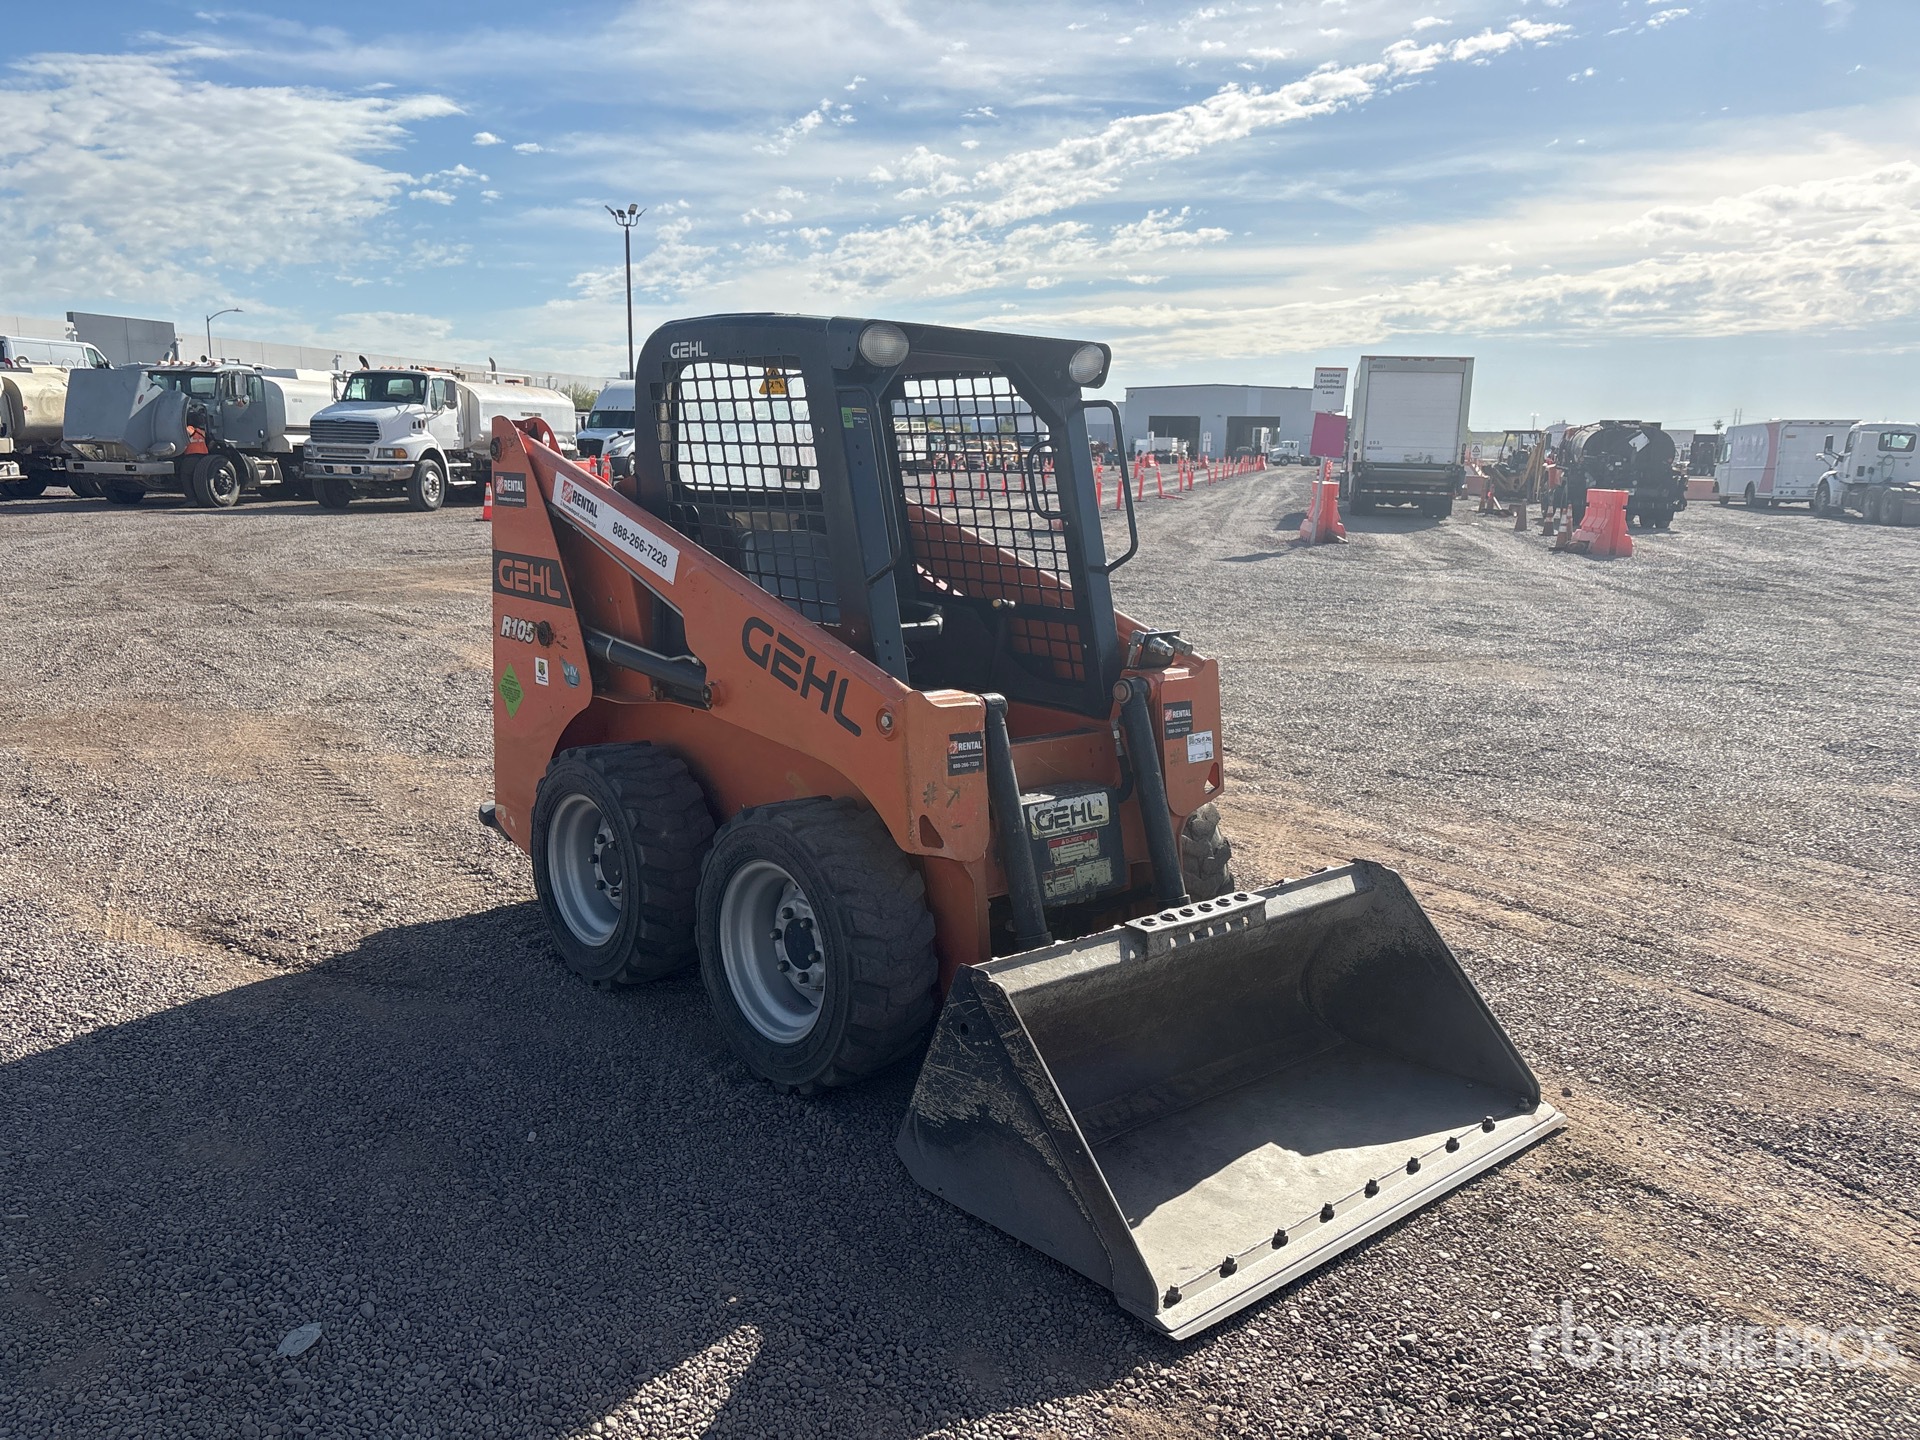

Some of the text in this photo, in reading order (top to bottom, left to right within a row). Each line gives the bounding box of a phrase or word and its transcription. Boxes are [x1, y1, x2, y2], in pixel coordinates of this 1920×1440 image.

[670, 340, 708, 359] GEHL
[503, 479, 525, 493] RENTAL
[572, 490, 598, 518] RENTAL
[612, 521, 668, 569] 888-266-7228
[498, 558, 562, 599] GEHL
[500, 615, 535, 644] R105
[742, 616, 862, 737] GEHL
[1172, 708, 1192, 719] RENTAL
[958, 740, 983, 752] RENTAL
[1035, 800, 1103, 832] GEHL
